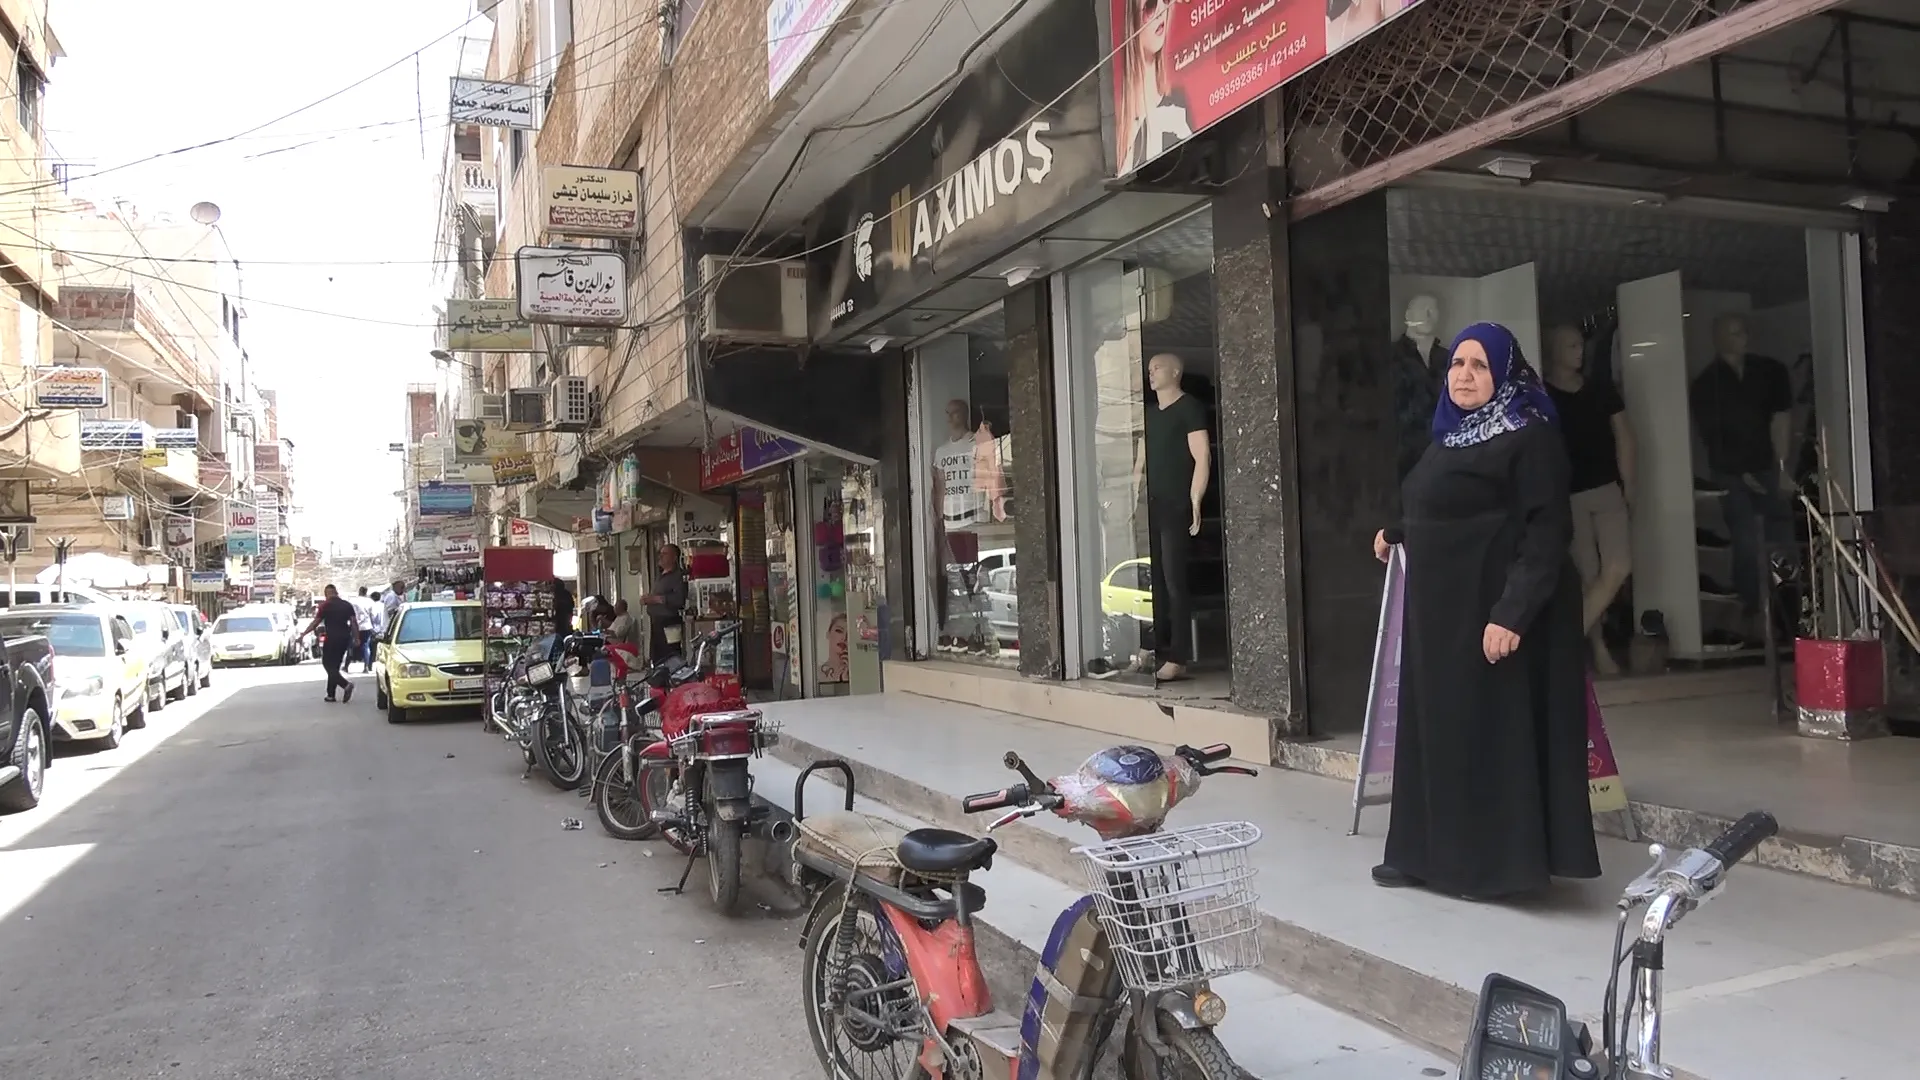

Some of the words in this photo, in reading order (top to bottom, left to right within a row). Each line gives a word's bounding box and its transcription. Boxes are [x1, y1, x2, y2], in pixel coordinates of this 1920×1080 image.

[1203, 23, 1235, 53] عدسات
[1259, 20, 1287, 53] علي
[1173, 41, 1201, 71] لاصقة
[1208, 63, 1264, 107] 0993592365
[1269, 35, 1308, 68] 421434
[473, 116, 512, 127] AVOCAT
[575, 174, 607, 184] الدكتور
[580, 187, 611, 203] سليمان
[611, 189, 633, 205] فراز
[890, 121, 1053, 272] MAXIMOS
[556, 255, 593, 267] الدكتور
[537, 266, 575, 292] قاسم
[575, 271, 603, 294] الدين
[599, 275, 616, 294] نور
[958, 470, 970, 480] IT
[682, 521, 718, 537] بصريات
